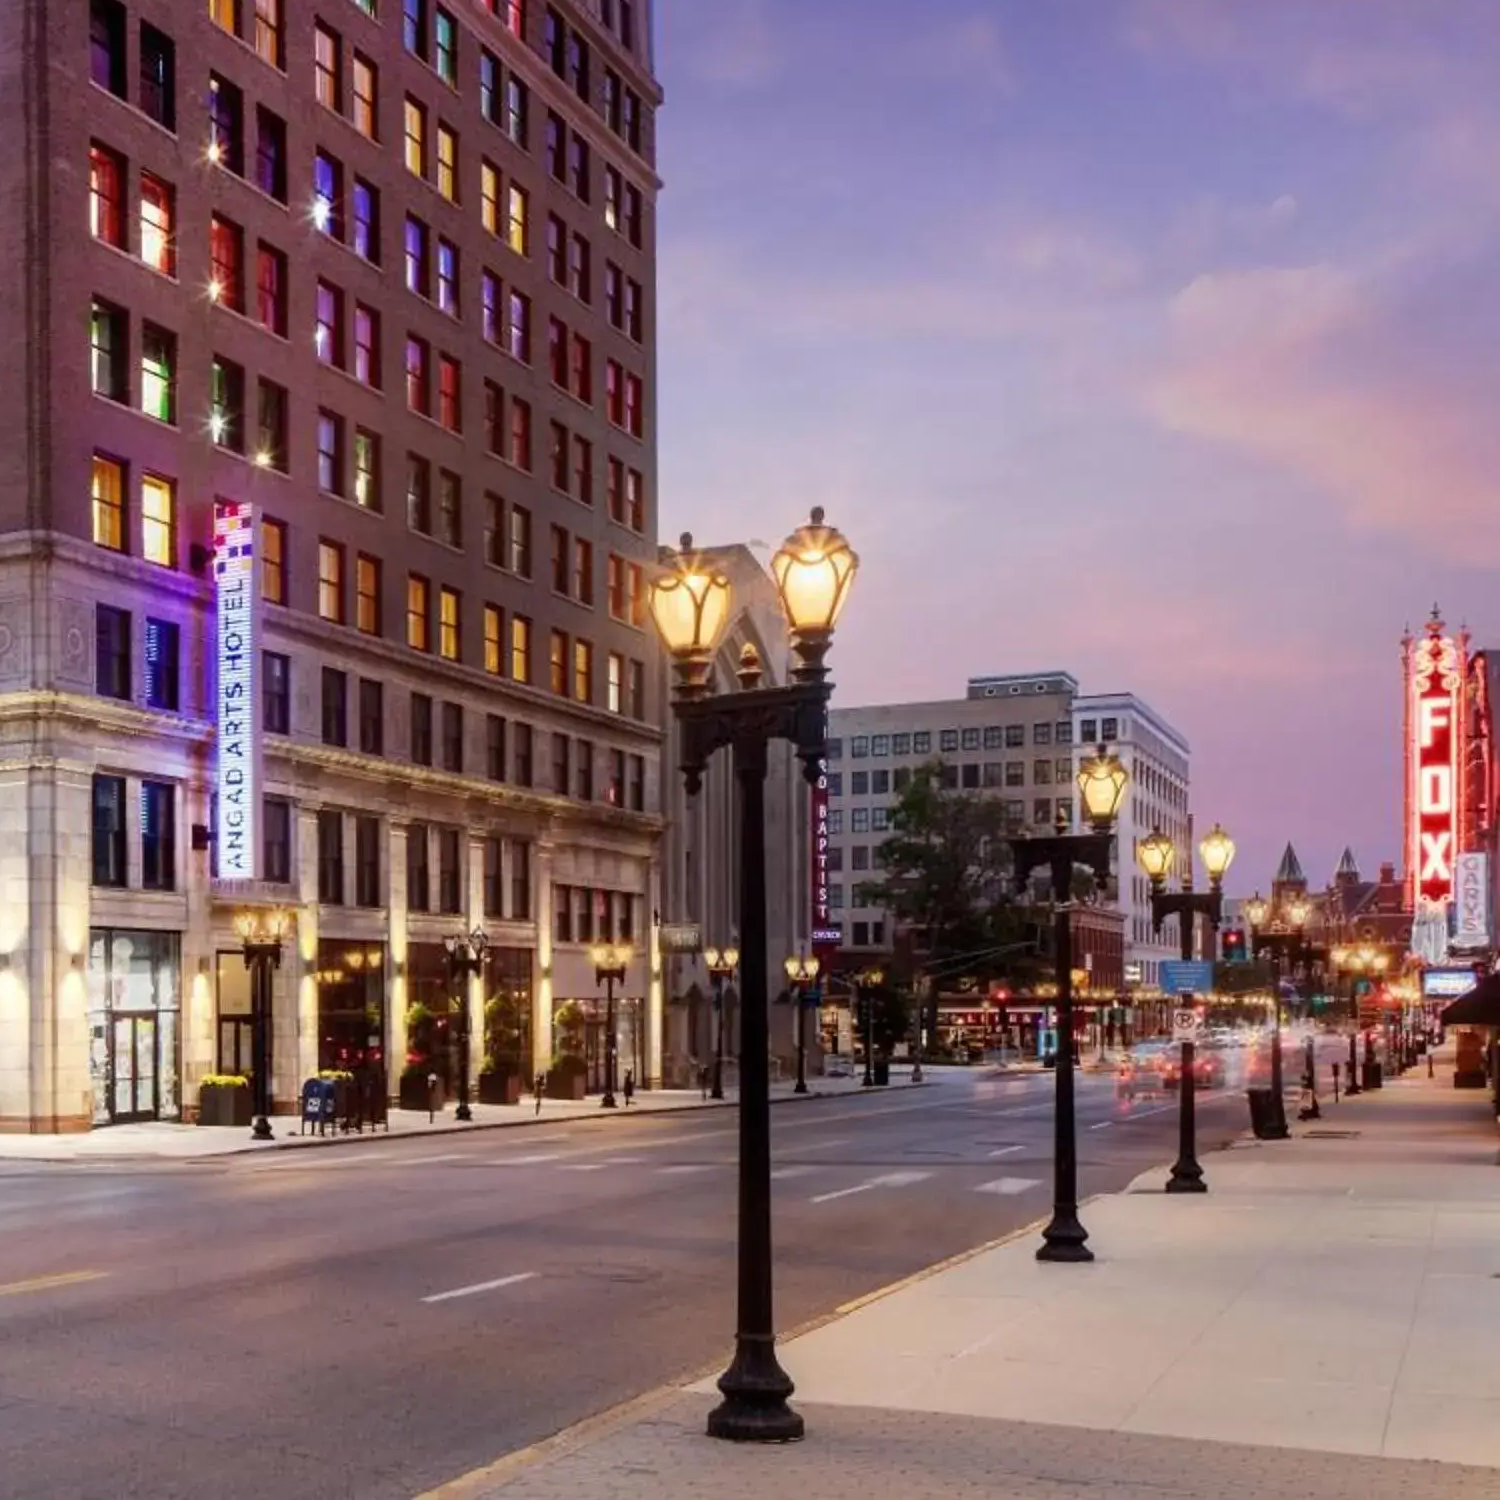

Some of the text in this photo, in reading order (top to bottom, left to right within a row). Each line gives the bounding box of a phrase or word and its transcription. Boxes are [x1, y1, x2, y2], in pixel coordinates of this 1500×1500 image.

[224, 577, 243, 869] ANGAD ARTS HOTEL
[1420, 697, 1451, 881] FOX
[817, 804, 828, 919] BAPTIST
